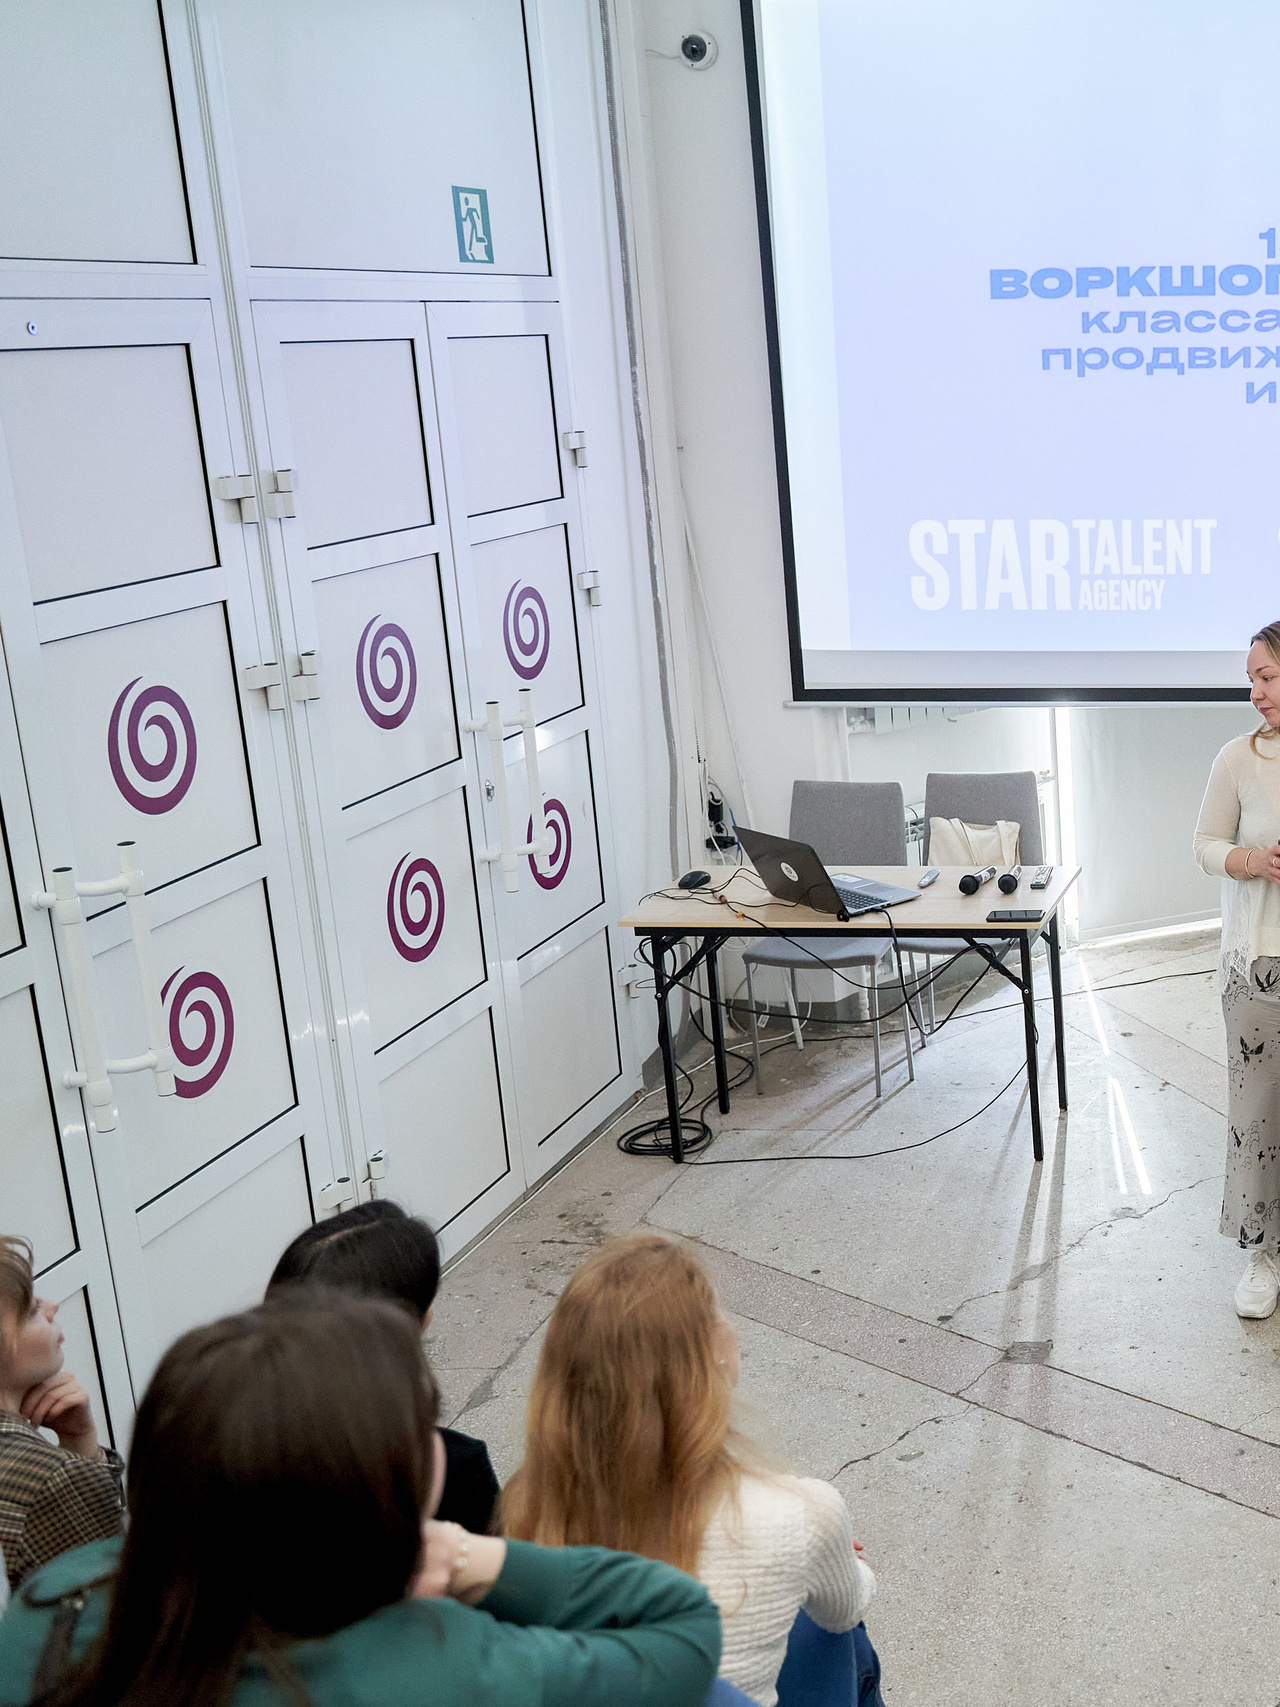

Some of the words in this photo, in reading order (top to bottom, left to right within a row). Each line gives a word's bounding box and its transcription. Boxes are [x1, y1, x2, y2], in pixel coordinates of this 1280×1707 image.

[909, 519, 1072, 611] STAR
[1072, 519, 1218, 575] TALENT
[1078, 579, 1166, 611] AGENCY
